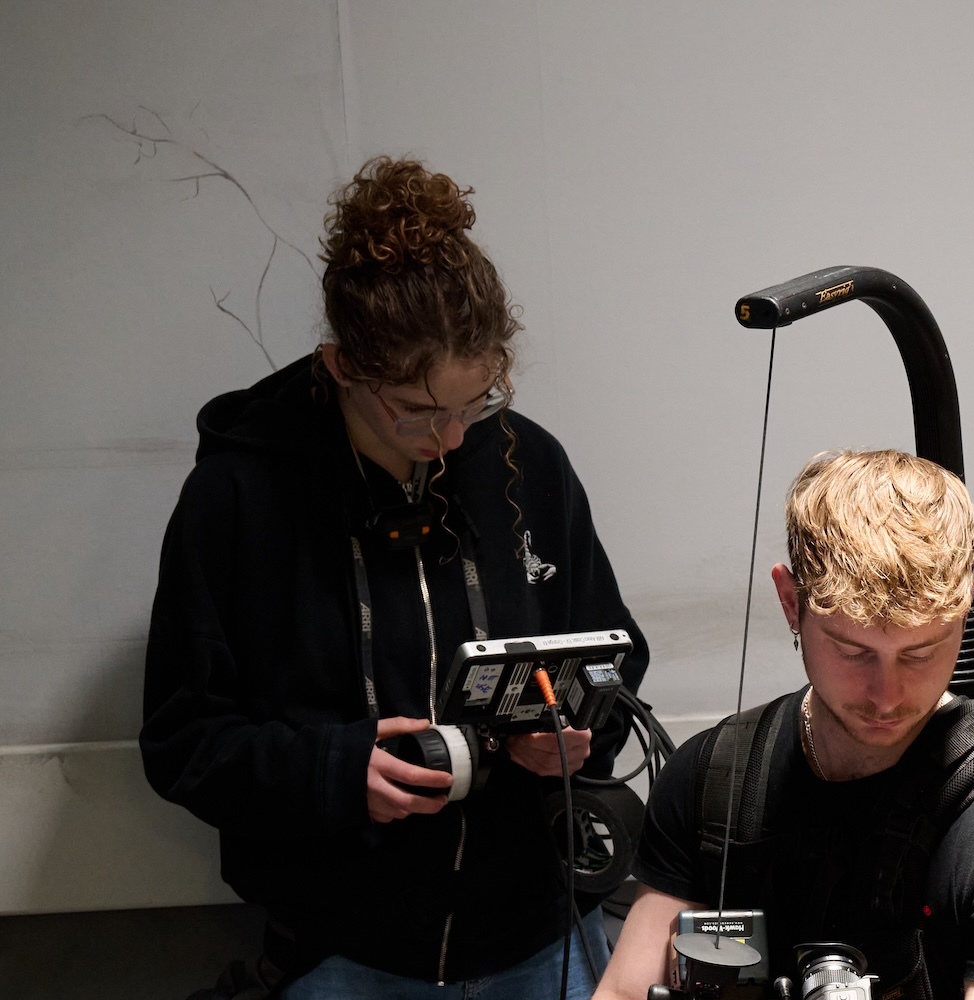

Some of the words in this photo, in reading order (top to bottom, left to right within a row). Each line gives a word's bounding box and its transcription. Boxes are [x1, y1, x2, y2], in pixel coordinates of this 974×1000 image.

[740, 304, 751, 321] 5
[463, 558, 479, 586] ARRI
[359, 602, 372, 633] ARRI
[364, 676, 377, 705] ARRI
